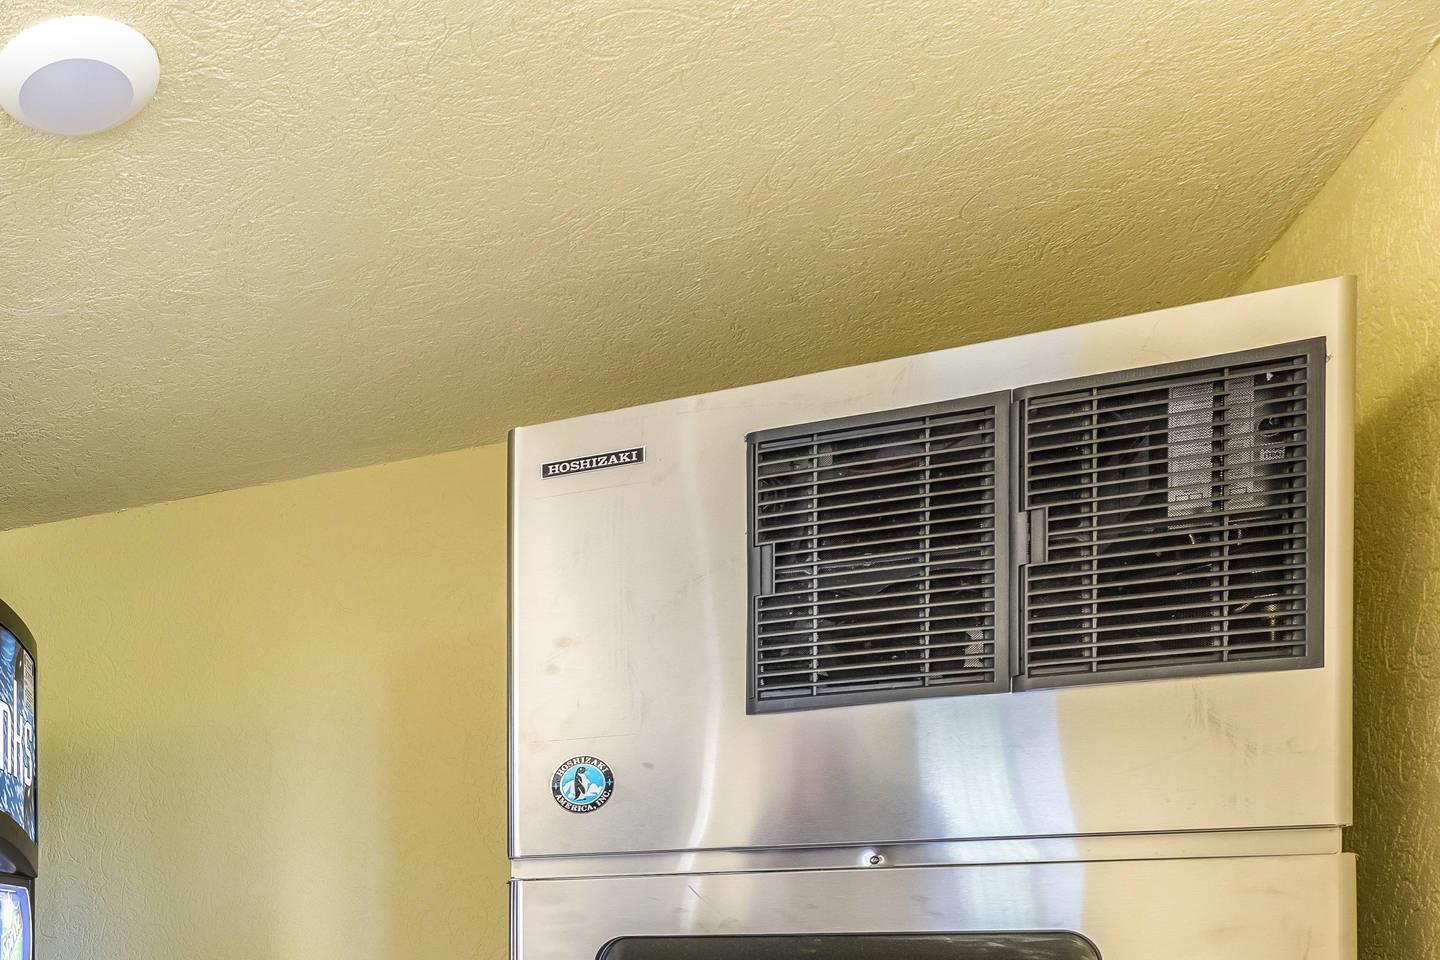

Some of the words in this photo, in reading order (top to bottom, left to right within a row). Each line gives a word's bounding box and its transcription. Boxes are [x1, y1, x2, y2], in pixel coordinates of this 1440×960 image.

[547, 450, 638, 476] HOSHIZAKI
[556, 757, 608, 777] HOSHIZAKI
[555, 794, 597, 812] AMERICA,
[596, 789, 612, 806] INC.
